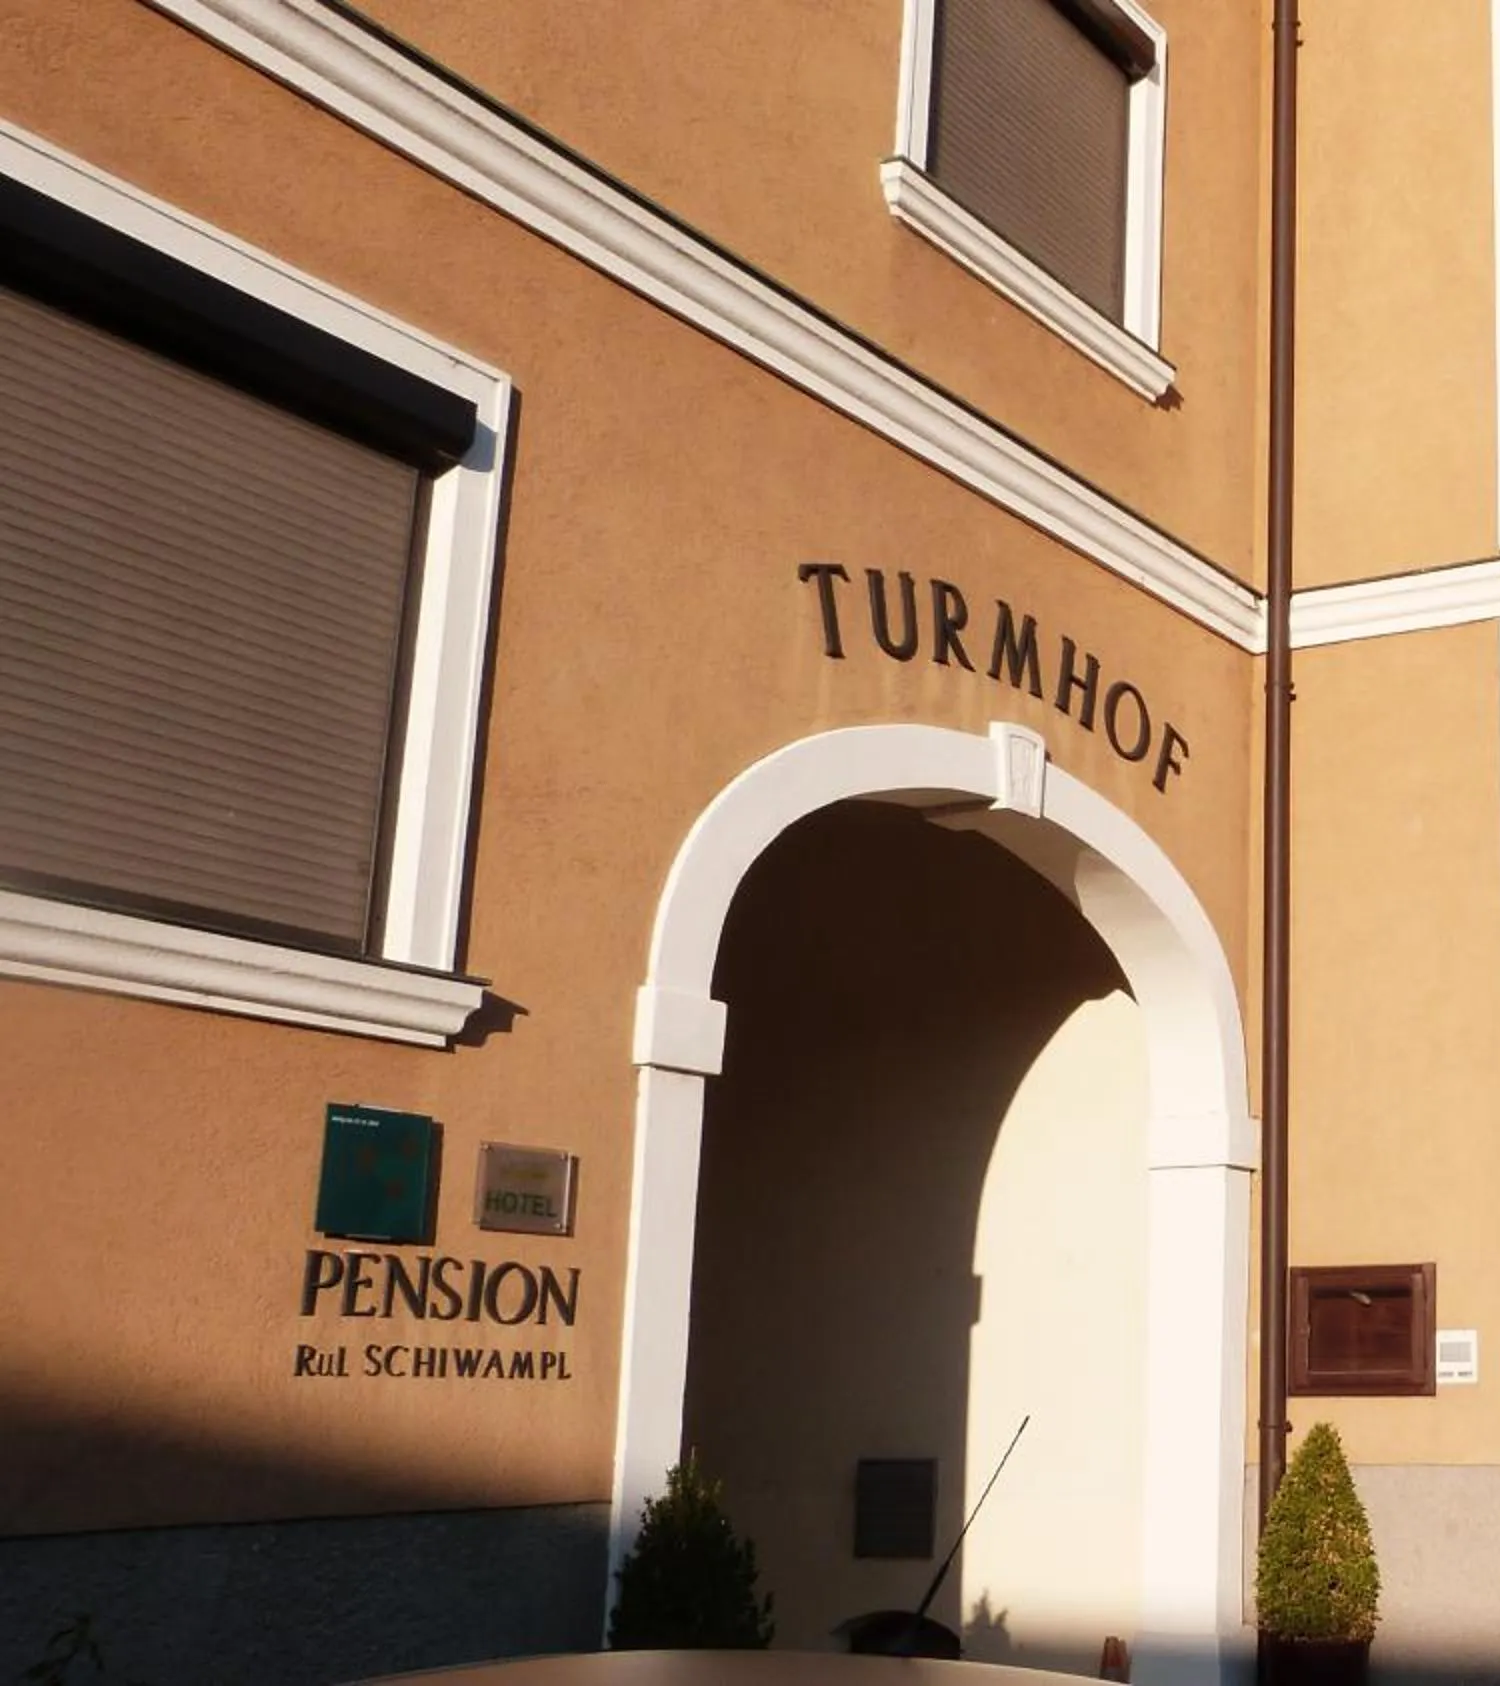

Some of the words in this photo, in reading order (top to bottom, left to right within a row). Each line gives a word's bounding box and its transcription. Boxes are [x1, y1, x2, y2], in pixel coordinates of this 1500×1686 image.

[797, 563, 1190, 795] TURMHOF
[484, 1189, 558, 1218] HOTEL
[300, 1250, 581, 1326] PENSION
[364, 1343, 572, 1380] SCHIWAMPL
